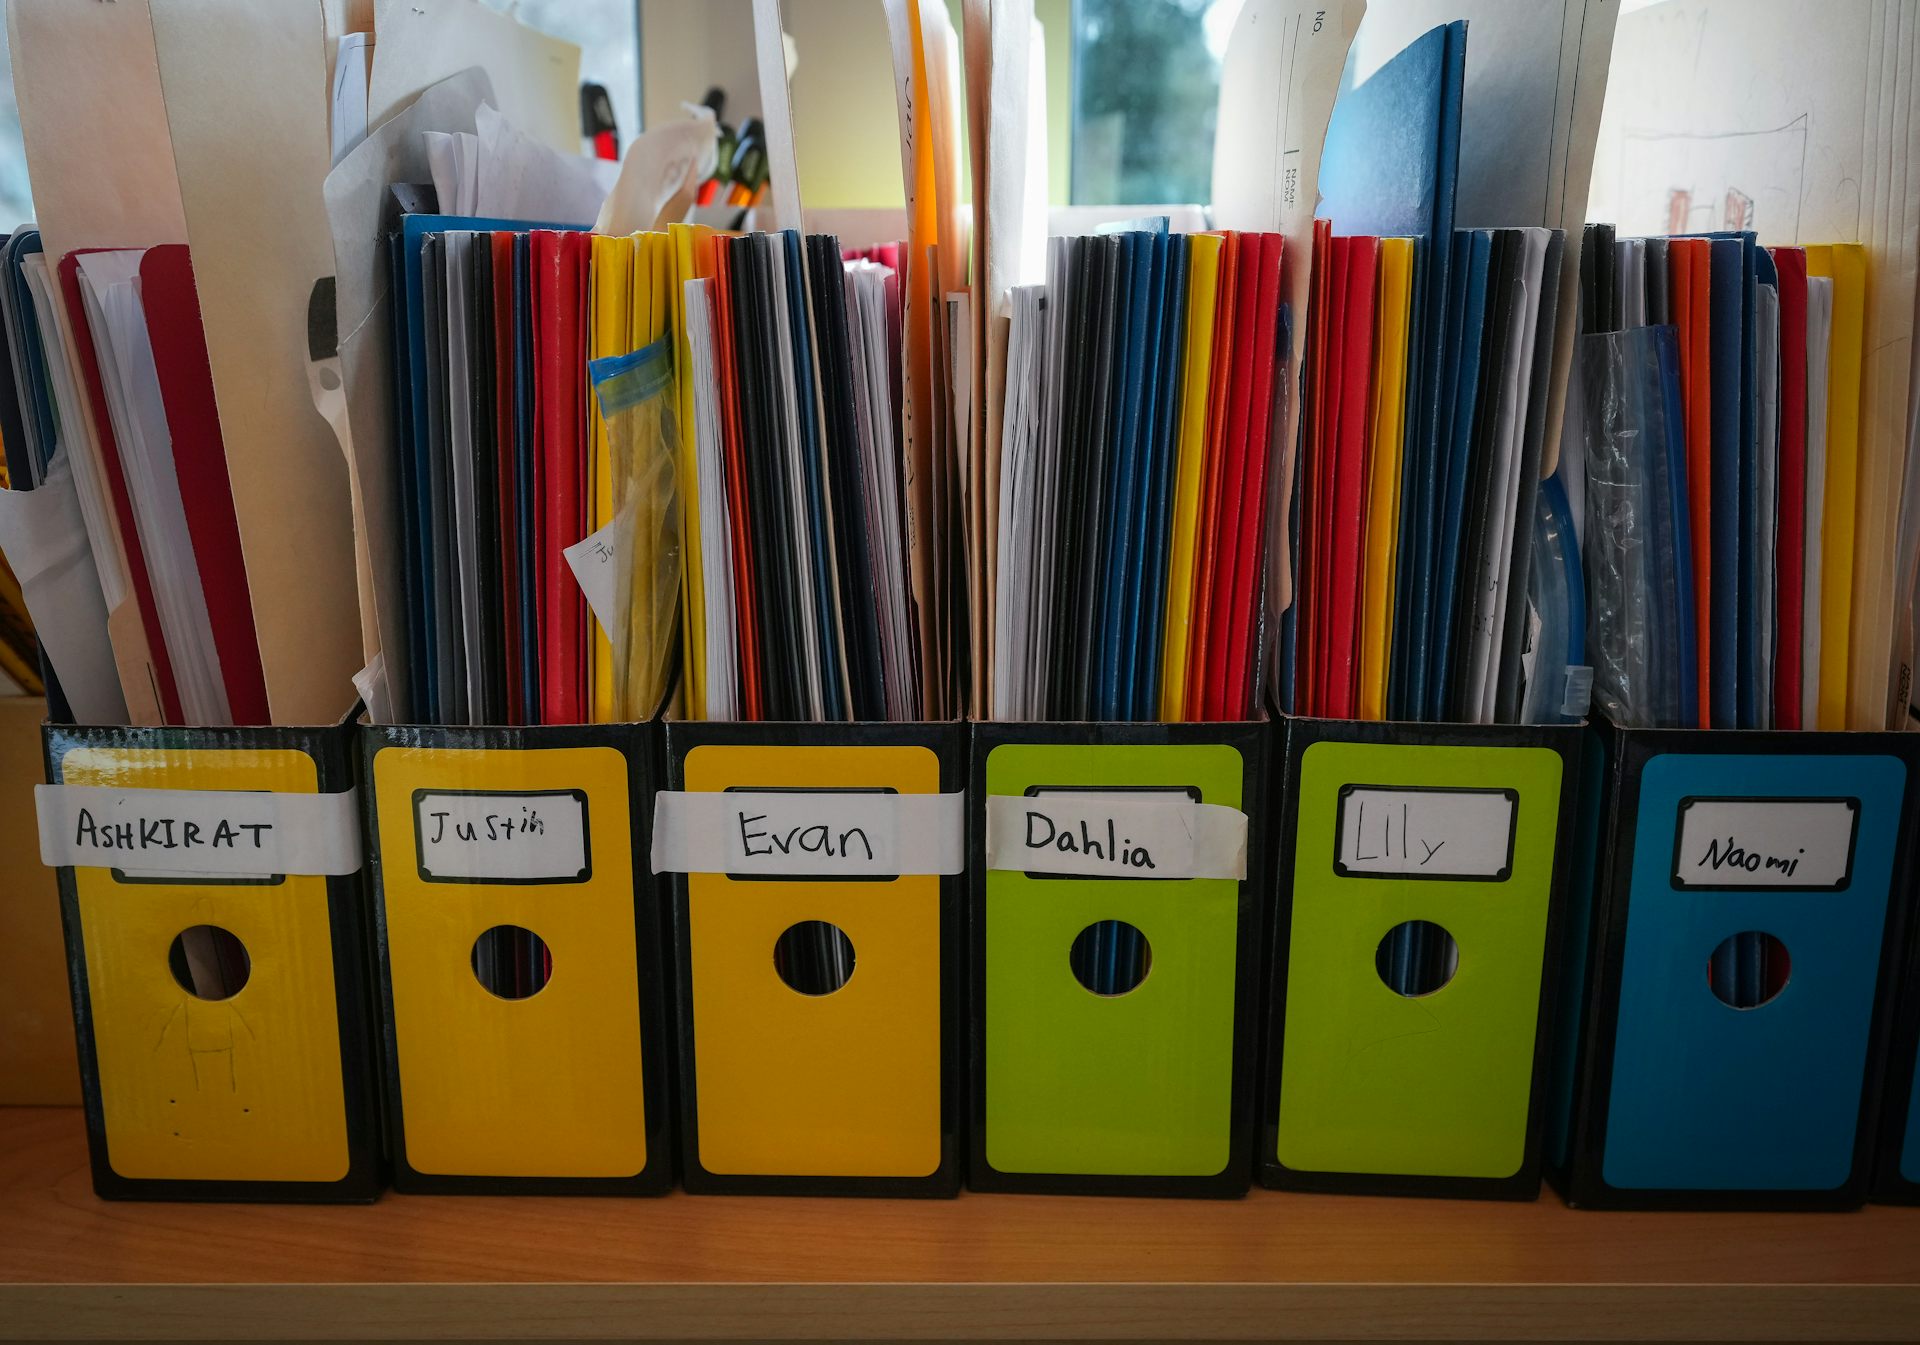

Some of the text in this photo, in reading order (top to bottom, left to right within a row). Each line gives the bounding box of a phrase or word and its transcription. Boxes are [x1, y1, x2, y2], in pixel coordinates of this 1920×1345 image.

[1311, 11, 1326, 36] NO.
[1288, 168, 1297, 210] NAME
[430, 806, 545, 845] Justin
[739, 811, 873, 861] Evan
[1026, 811, 1156, 869] Dahlia
[1356, 801, 1445, 866] Lily
[1698, 836, 1805, 877] Naomi
